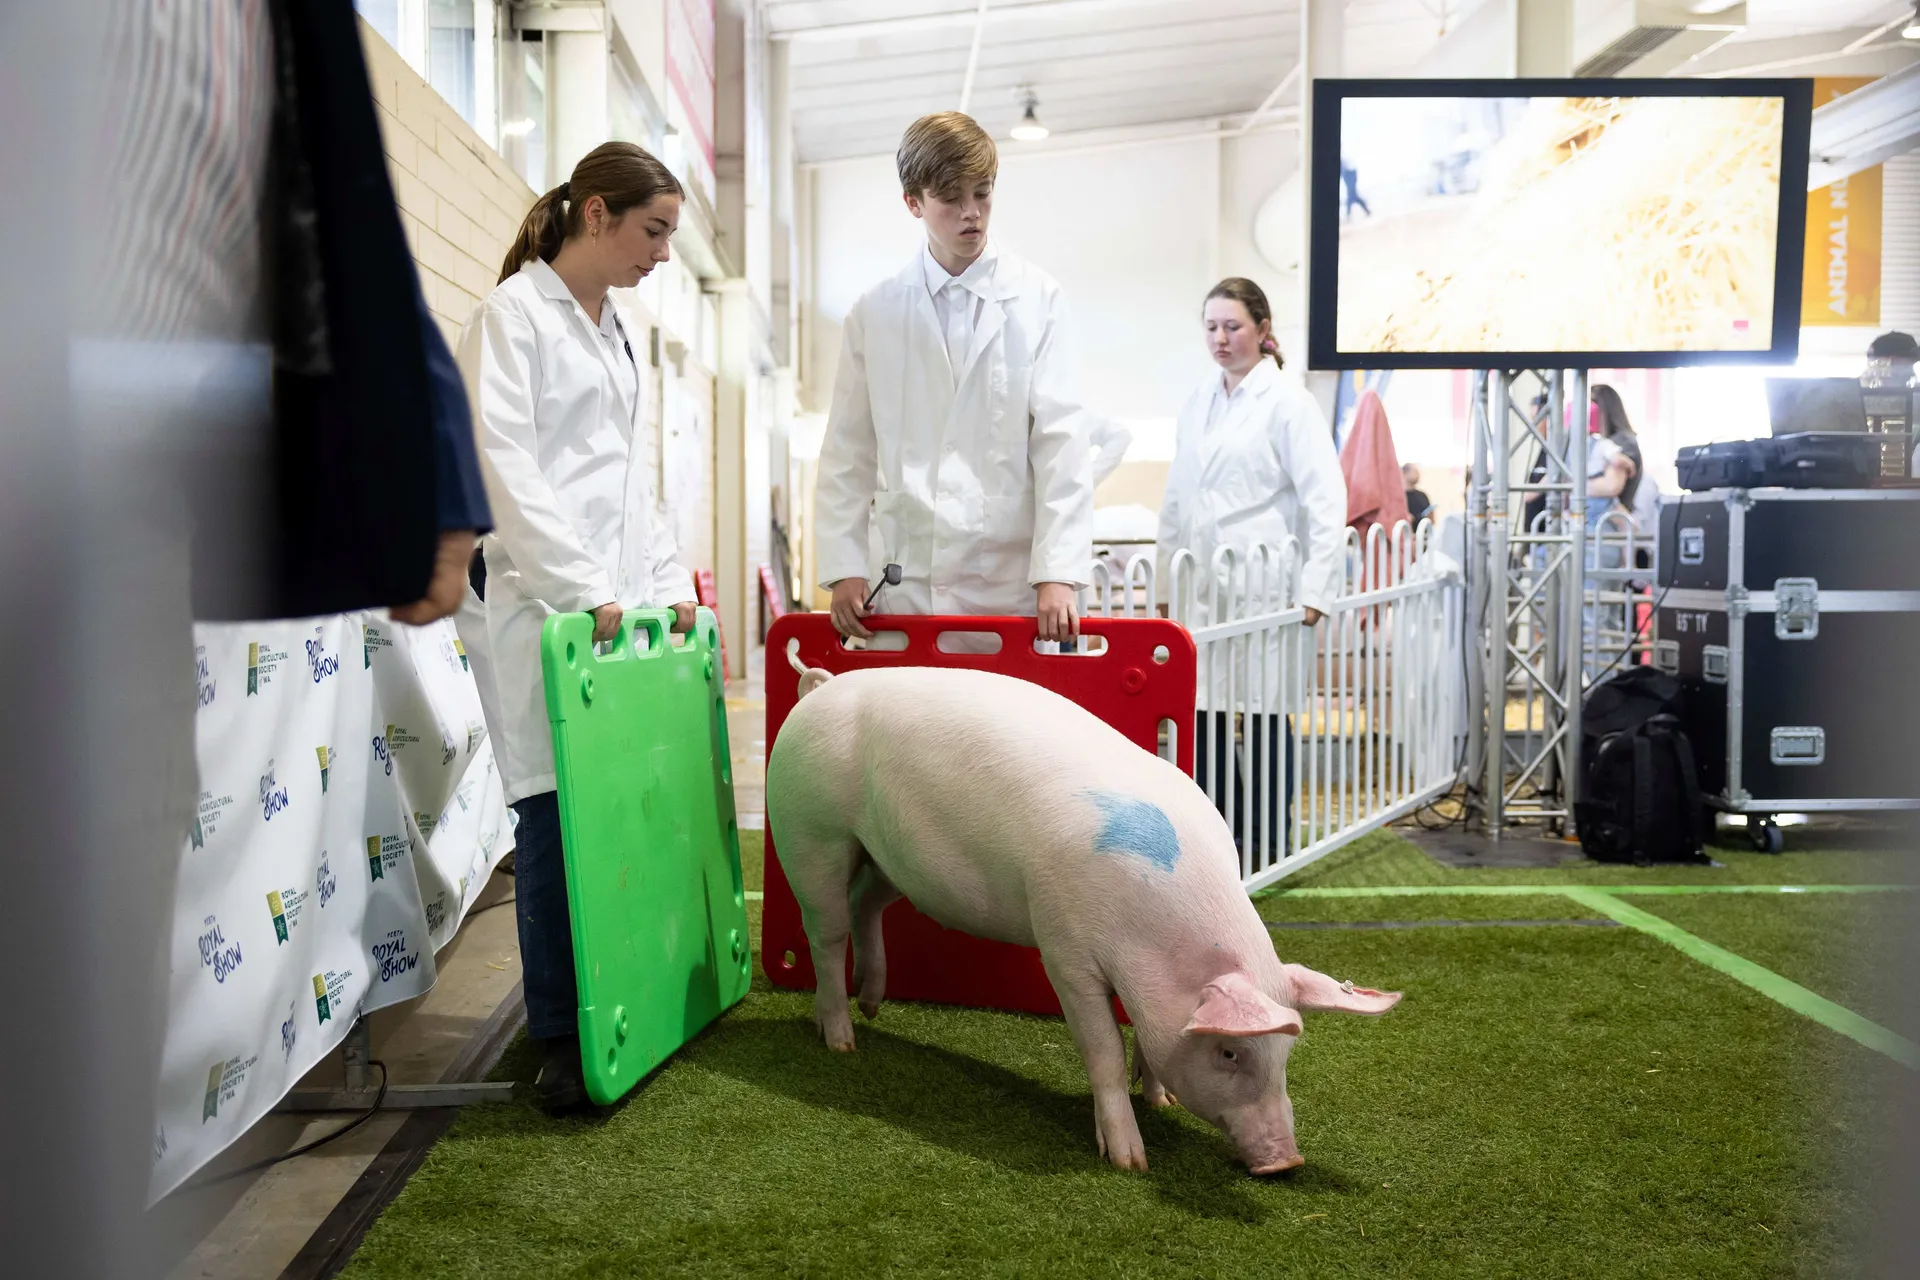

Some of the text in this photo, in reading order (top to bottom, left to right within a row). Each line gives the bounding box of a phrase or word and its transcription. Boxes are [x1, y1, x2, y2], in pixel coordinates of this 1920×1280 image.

[1828, 215, 1848, 317] ANIMAL
[196, 656, 209, 681] YAL
[313, 653, 339, 683] SHOW
[197, 679, 216, 709] HOW
[263, 787, 289, 821] SHOW
[201, 811, 221, 825] SOCIETY
[382, 834, 400, 844] ROYAL
[382, 850, 405, 861] SOCIETY
[281, 887, 297, 899] ROYAL
[286, 904, 303, 920] SOCIETY
[387, 930, 404, 938] PERTH
[198, 924, 225, 968] ROYAL
[372, 937, 406, 970] ROYAL
[213, 942, 242, 984] SHOW
[381, 951, 419, 982] SHOW
[326, 969, 353, 990] AGRICULTURAL
[328, 984, 345, 1000] SOCIETY
[220, 1073, 246, 1093] SOCIETY
[226, 1089, 235, 1101] WA
